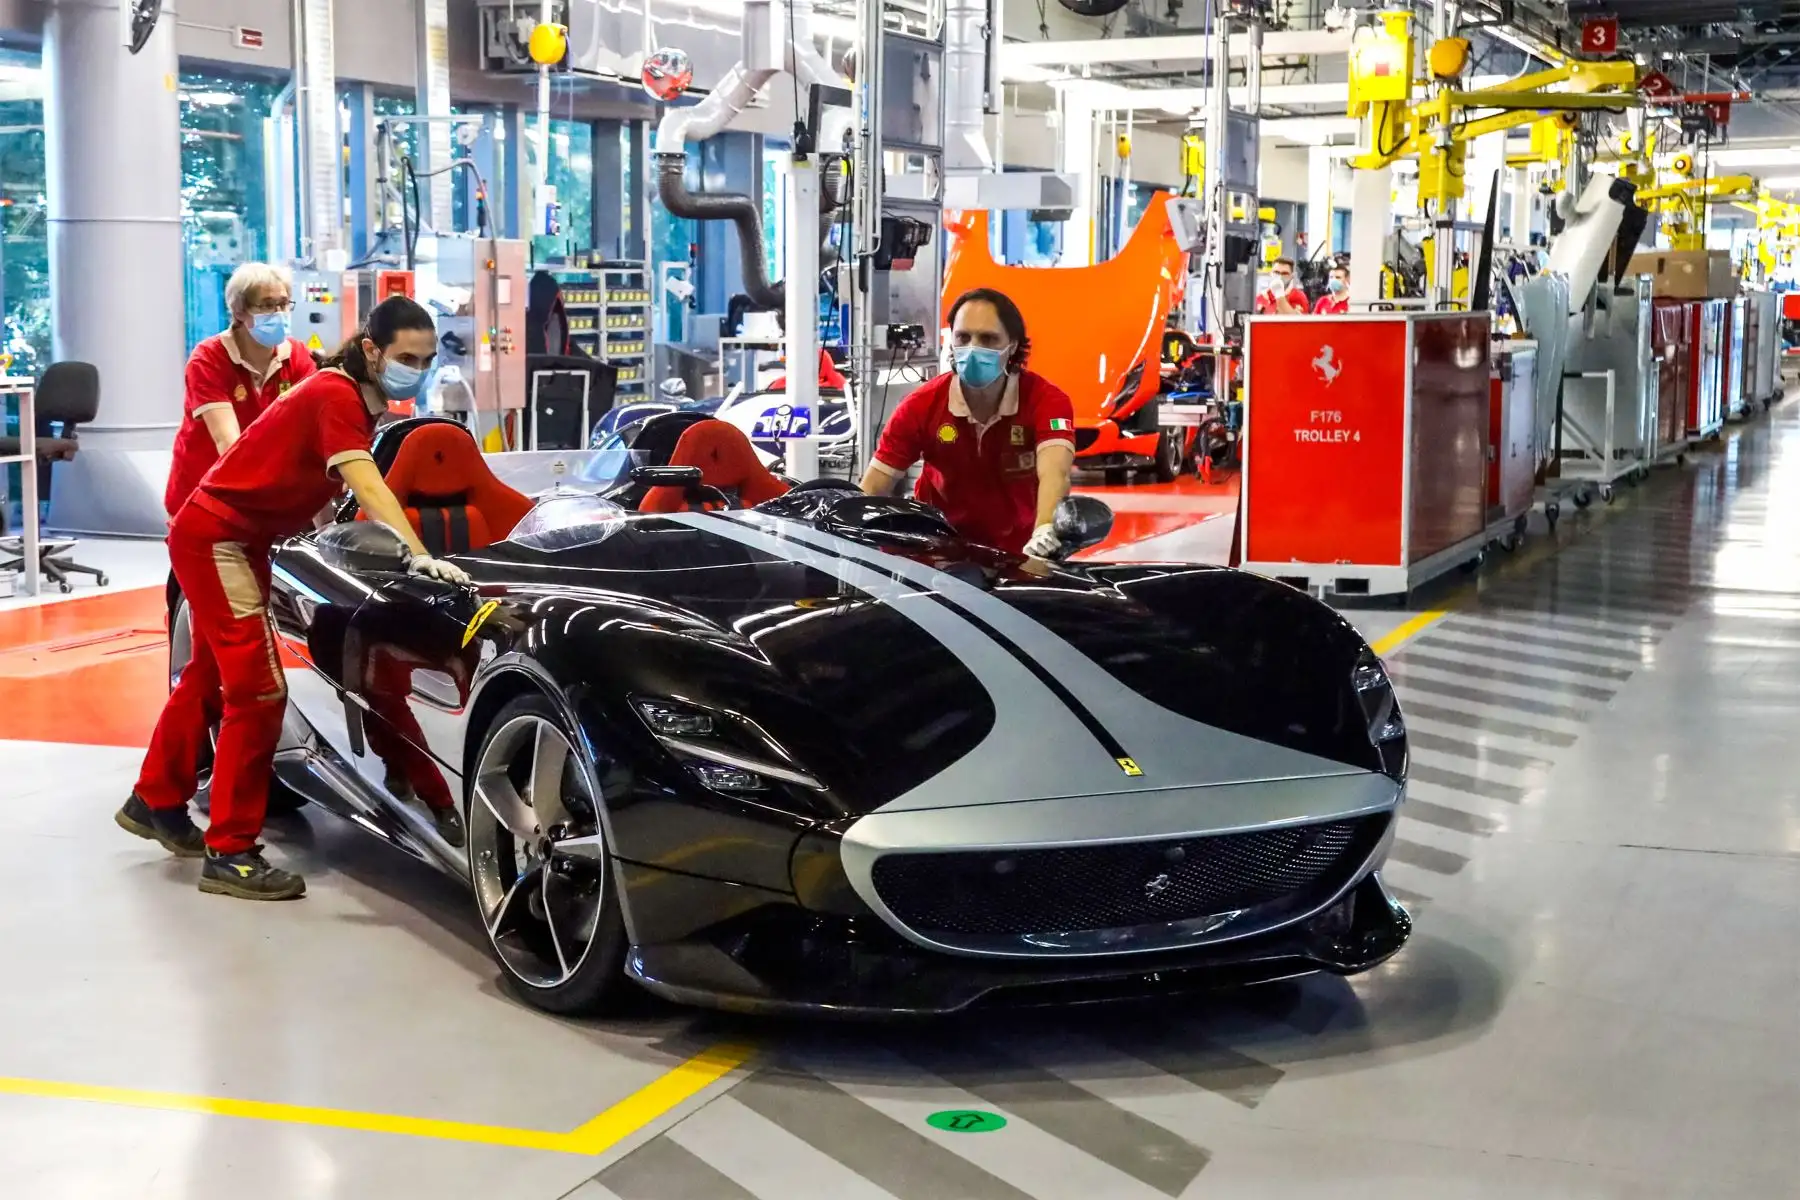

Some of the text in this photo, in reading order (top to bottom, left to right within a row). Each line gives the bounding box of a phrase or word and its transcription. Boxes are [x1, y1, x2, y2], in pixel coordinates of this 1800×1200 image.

[1593, 26, 1605, 46] 3
[1642, 78, 1662, 96] 2
[1713, 105, 1721, 119] 1
[1310, 410, 1342, 423] F176
[1293, 429, 1361, 442] TROLLEY 4
